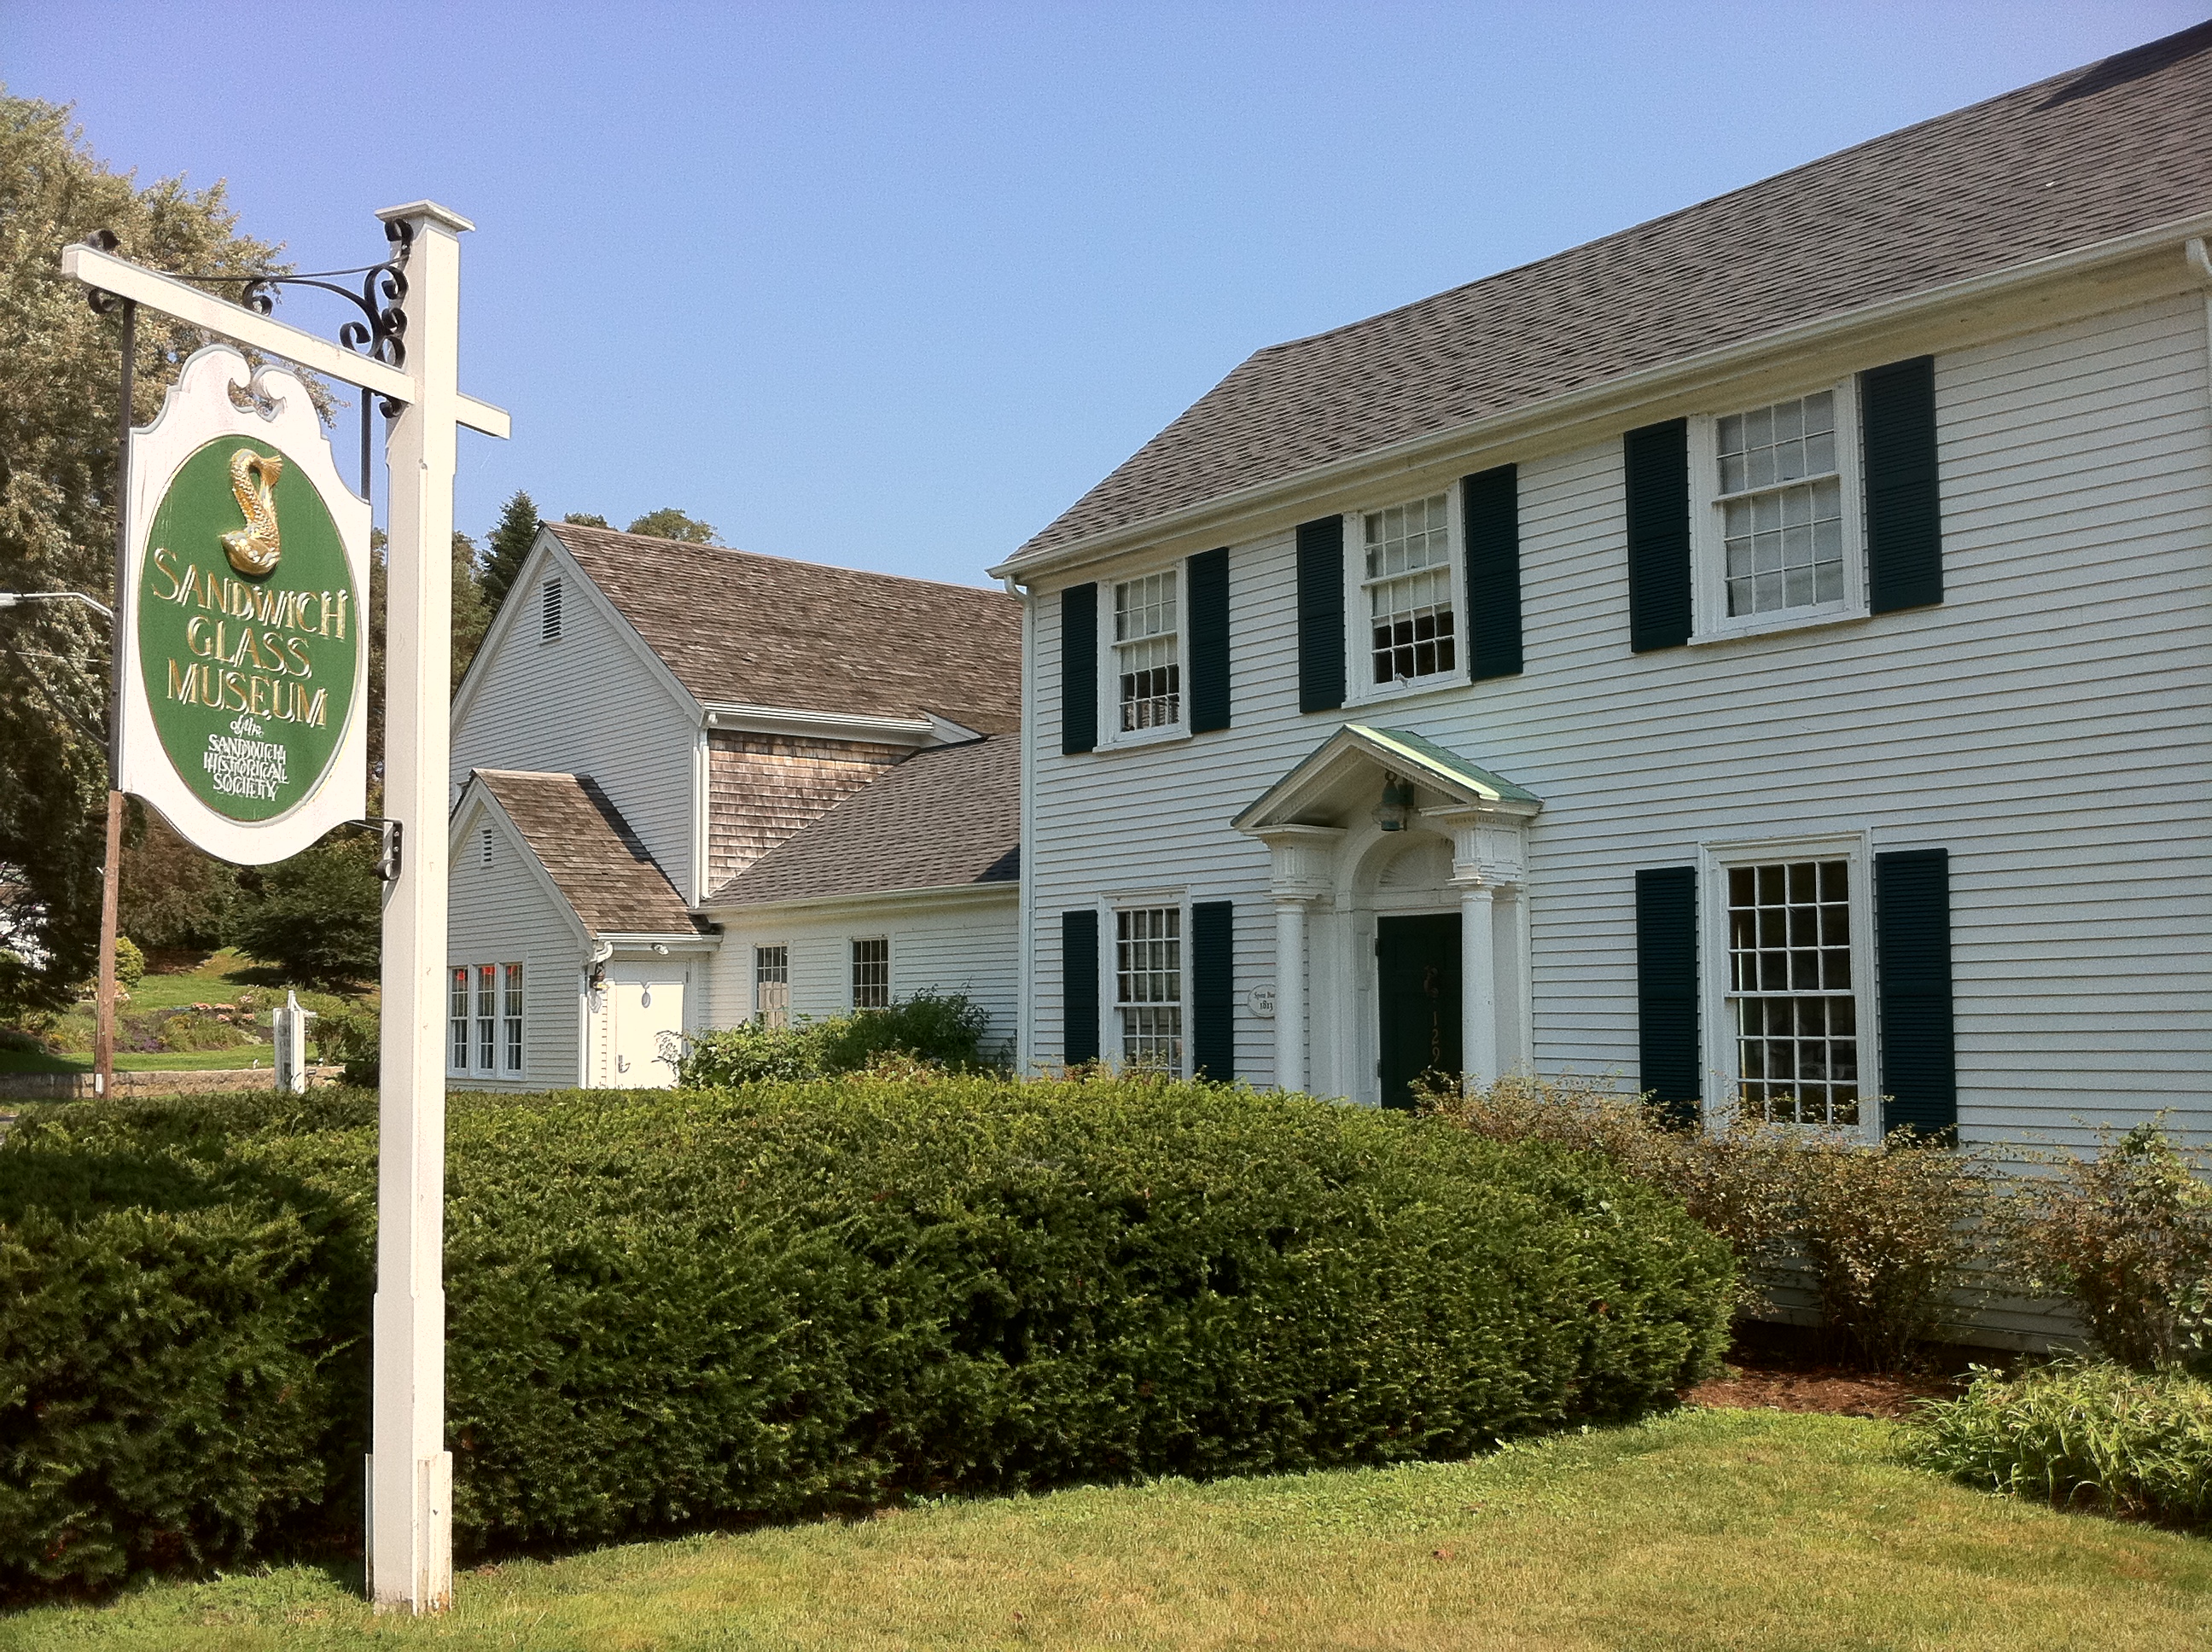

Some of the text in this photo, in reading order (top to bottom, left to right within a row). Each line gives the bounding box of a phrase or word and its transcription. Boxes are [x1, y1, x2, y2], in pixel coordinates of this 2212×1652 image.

[153, 547, 348, 640] SANDWICH
[186, 615, 312, 679] GLASS
[166, 658, 329, 728] MUSEUM
[230, 715, 265, 737] of the
[203, 752, 289, 784] HISTORICAL
[208, 734, 287, 765] SANDWICH
[212, 773, 278, 801] SOCIETY
[1431, 1010, 1441, 1063] 129
